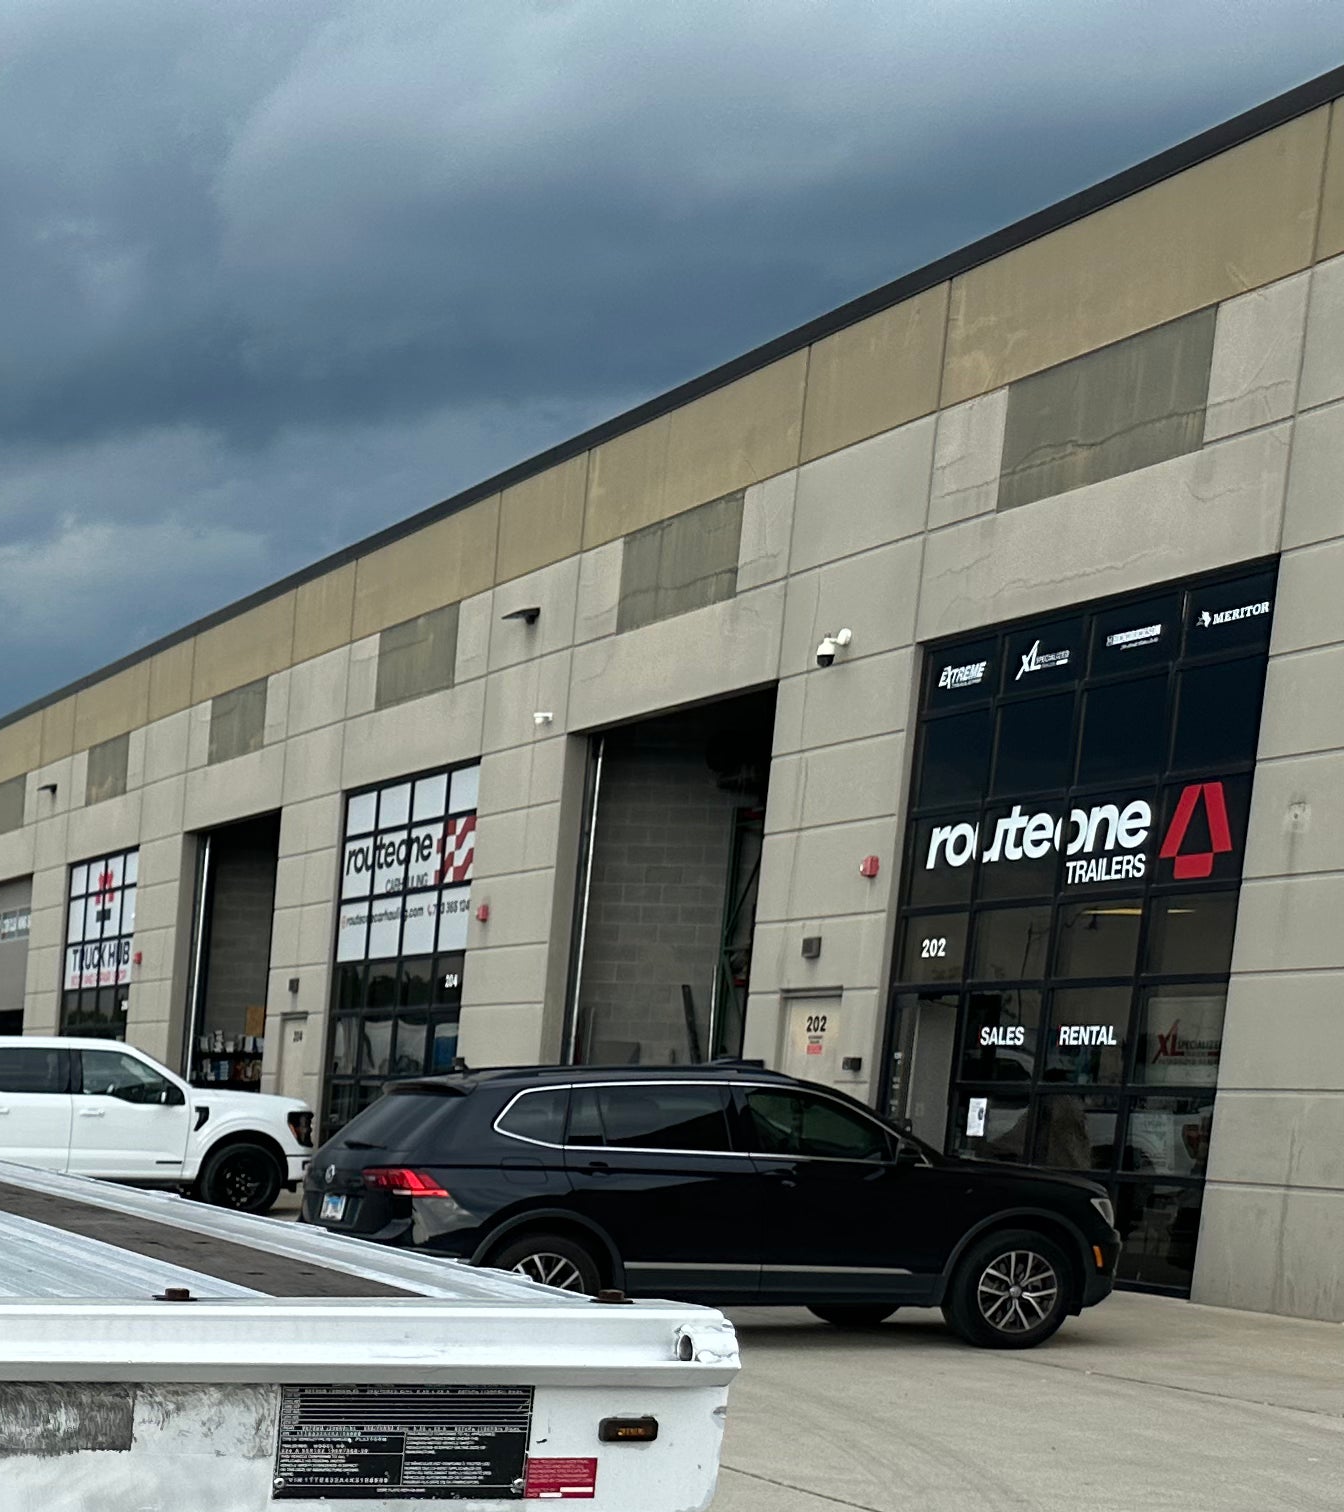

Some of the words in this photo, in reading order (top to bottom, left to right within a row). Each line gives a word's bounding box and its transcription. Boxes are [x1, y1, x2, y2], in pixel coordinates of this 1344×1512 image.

[1213, 601, 1270, 626] MERITOR
[1015, 640, 1042, 681] XL
[938, 661, 987, 689] EXTREME
[925, 799, 1152, 870] routeone
[346, 833, 433, 876] routeone
[1066, 853, 1146, 885] TRAILERS
[921, 938, 947, 958] 202
[806, 1015, 827, 1032] 202
[980, 1025, 1024, 1046] SALES
[1059, 1025, 1117, 1046] RENTAL
[1178, 1039, 1221, 1051] SPECIALIZE
